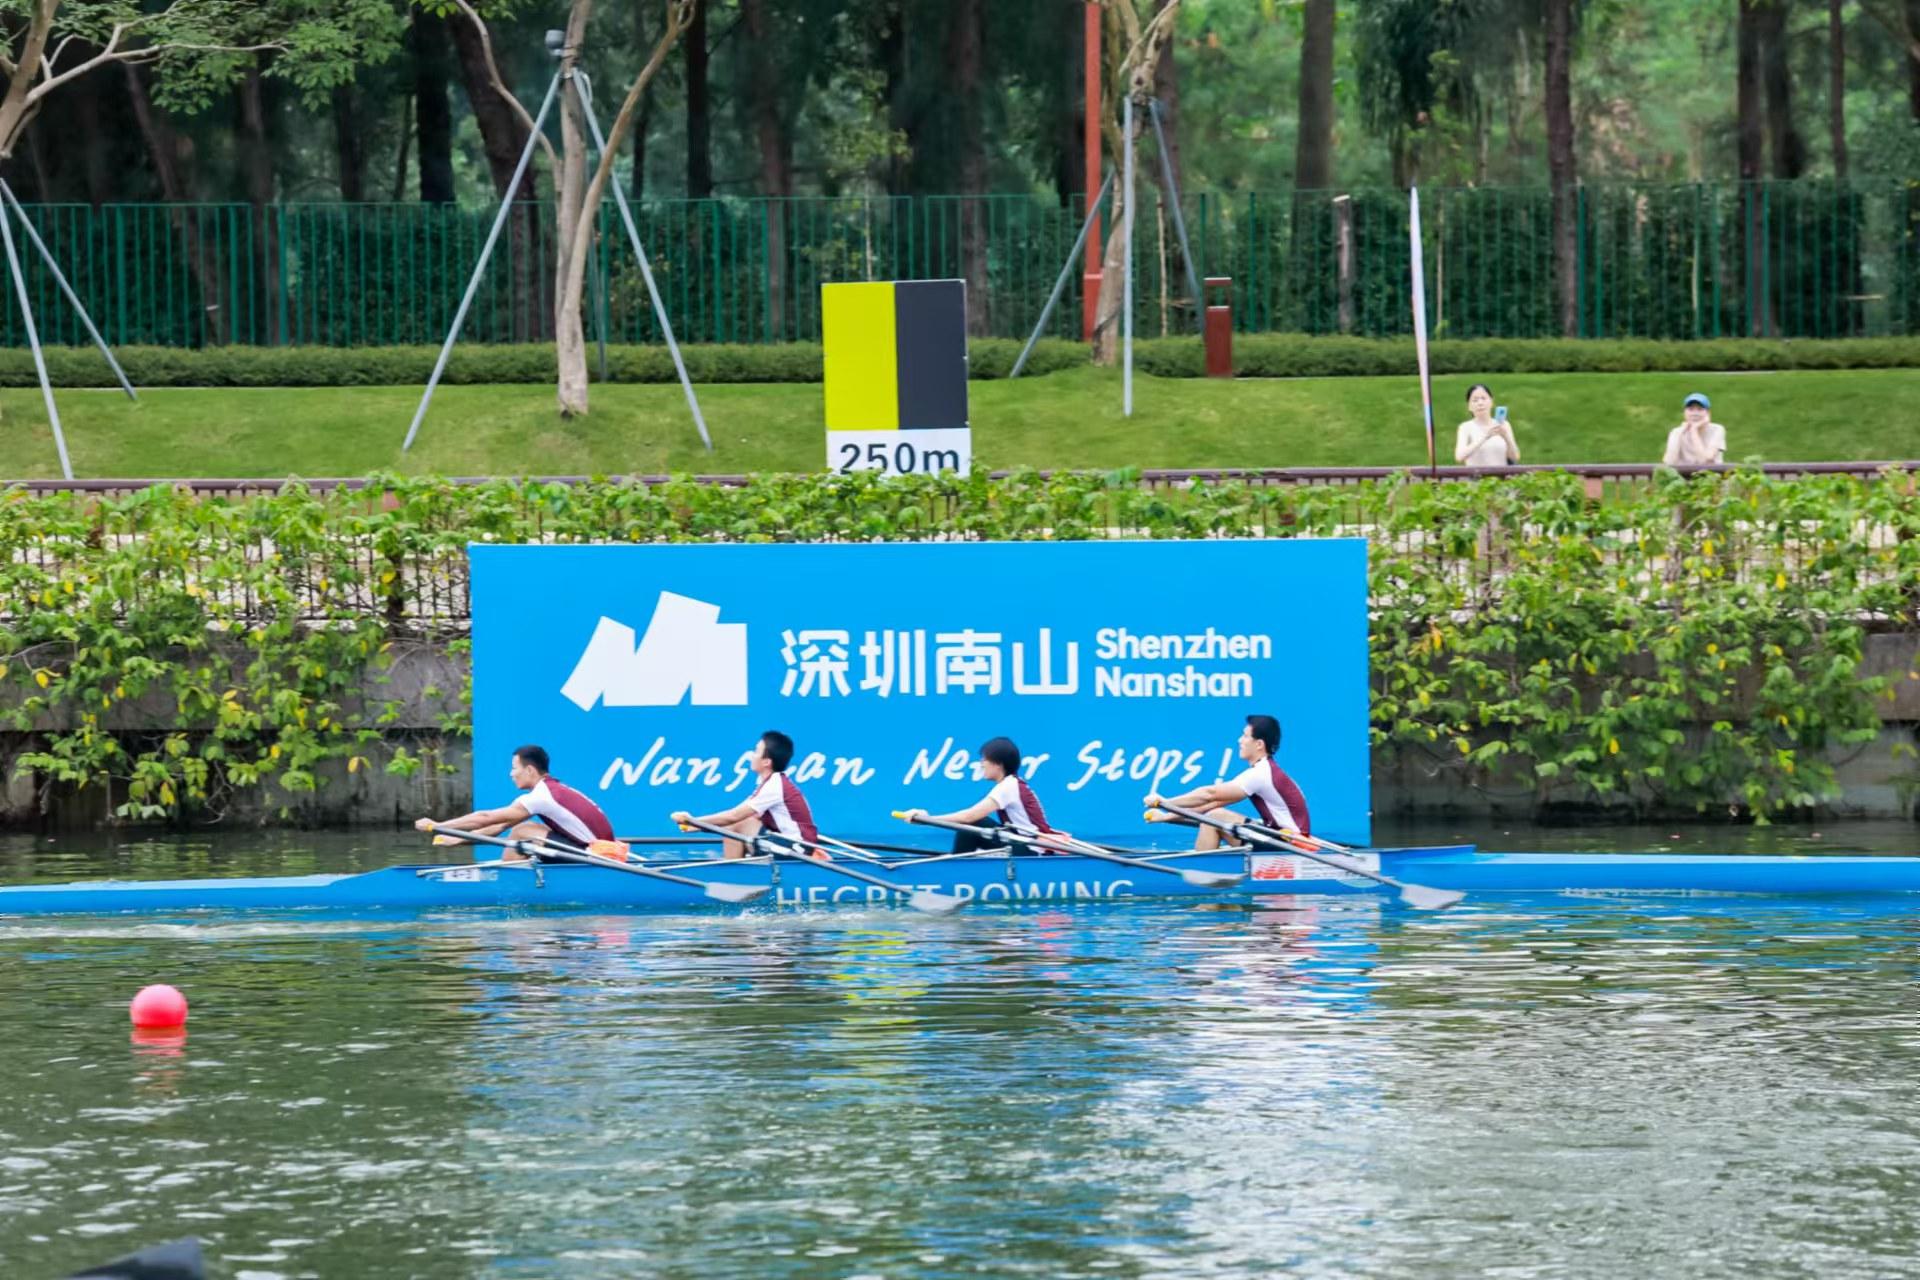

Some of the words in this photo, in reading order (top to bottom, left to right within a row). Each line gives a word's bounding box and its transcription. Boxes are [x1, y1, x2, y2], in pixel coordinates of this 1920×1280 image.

[840, 442, 960, 475] 250m
[1095, 627, 1272, 660] Shenzhen
[780, 628, 1079, 698] 深圳南山
[1095, 666, 1253, 698] Nanshan
[903, 736, 1050, 784] Ner
